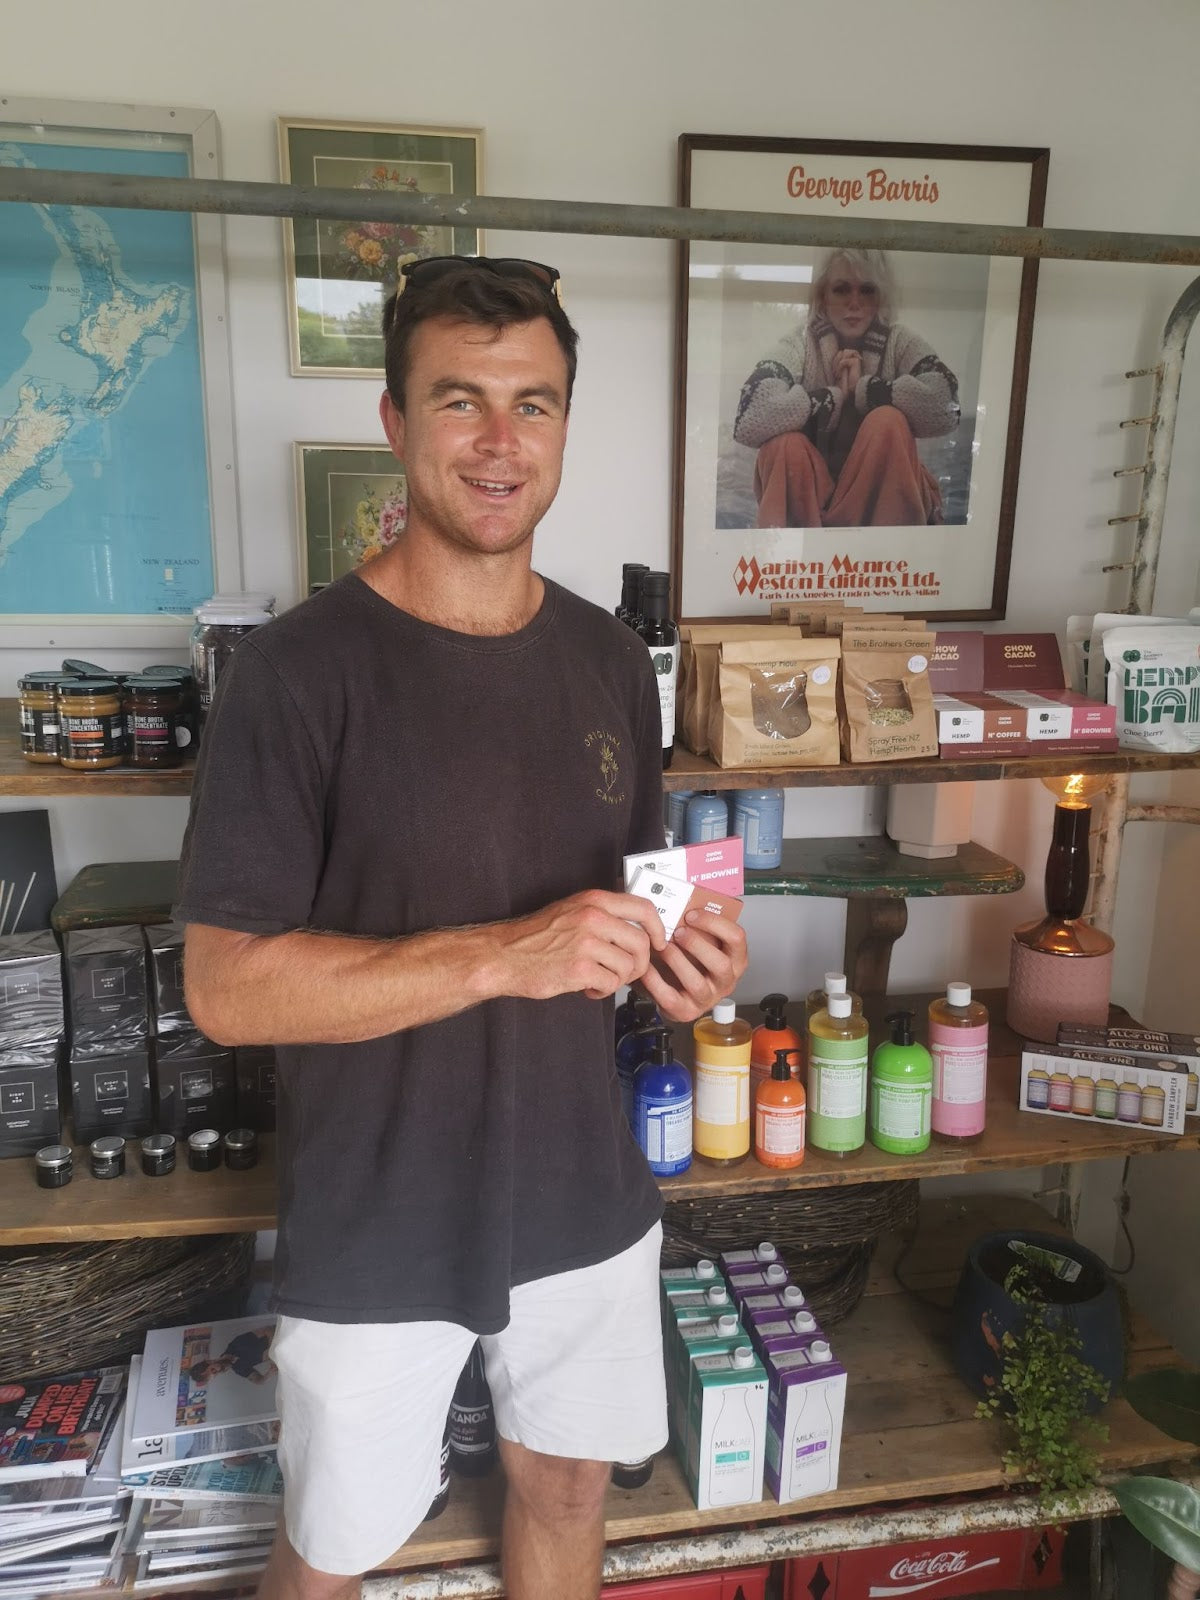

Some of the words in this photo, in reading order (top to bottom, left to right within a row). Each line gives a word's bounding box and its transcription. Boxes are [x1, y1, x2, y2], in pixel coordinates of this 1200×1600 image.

[787, 165, 863, 207] George
[867, 168, 939, 203] Barris
[733, 555, 824, 576] Marilyn
[827, 554, 908, 574] Monroe
[733, 573, 812, 596] Weston
[817, 573, 897, 589] Editions
[902, 572, 941, 587] Ltd.
[853, 639, 867, 648] The
[869, 639, 902, 648] Brothers
[904, 639, 930, 648] Green
[934, 645, 958, 653] HOW
[1004, 651, 1036, 659] CACAO
[1143, 729, 1164, 737] Berry
[868, 737, 889, 745] Spray
[870, 747, 891, 755] Hemp
[701, 867, 739, 881] BROWNIE
[1108, 1030, 1128, 1038] ALL
[1143, 1033, 1169, 1042] ONE!
[1107, 1040, 1127, 1048] ALL
[1143, 1044, 1169, 1053] ONE!
[1073, 1052, 1093, 1060] ALL
[1109, 1055, 1136, 1065] ONE!
[54, 1384, 79, 1406] HER
[15, 1395, 39, 1419] JULIA
[25, 1384, 62, 1428] DUMPED
[57, 1378, 98, 1435] BIRTHDAY!
[46, 1405, 68, 1423] ON
